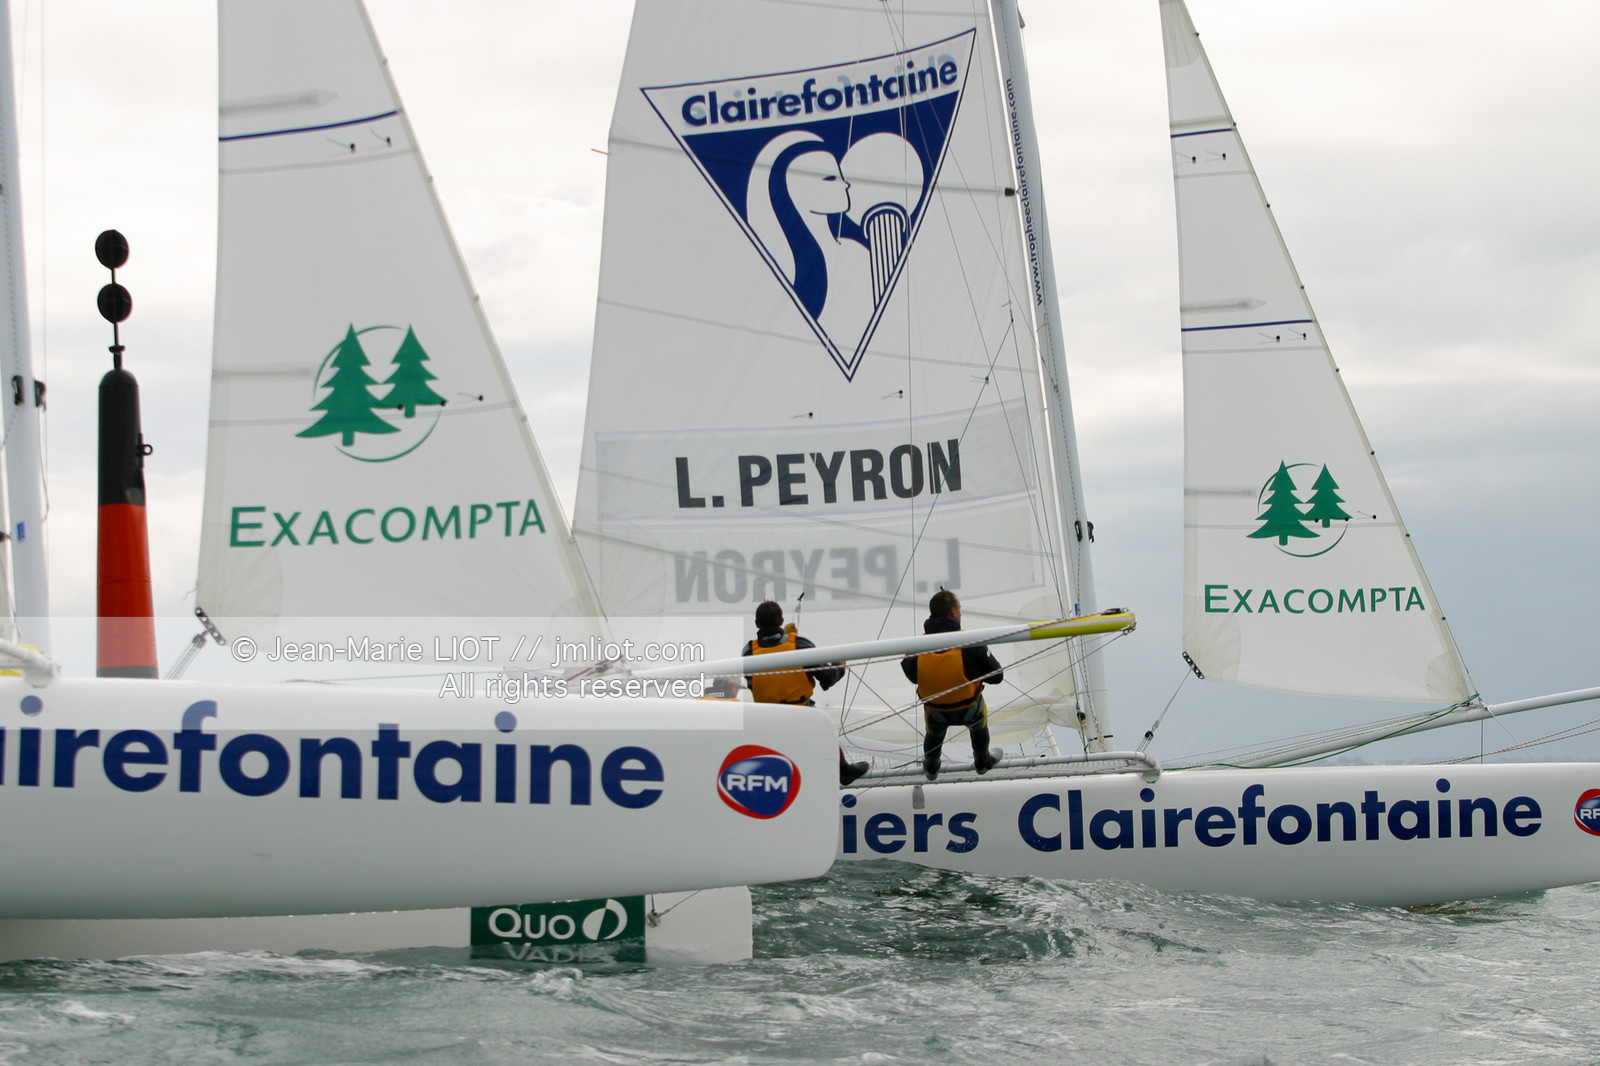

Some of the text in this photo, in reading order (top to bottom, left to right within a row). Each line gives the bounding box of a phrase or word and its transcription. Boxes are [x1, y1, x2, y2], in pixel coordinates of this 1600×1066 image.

[681, 60, 959, 126] Clairefontaine
[1006, 78, 1042, 306] www.tropheeclairefontaine.com
[675, 438, 963, 508] L. PEYRON
[0, 695, 663, 810] irefontaine
[726, 774, 788, 793] RFM
[1018, 778, 1542, 852] Clairefontaine
